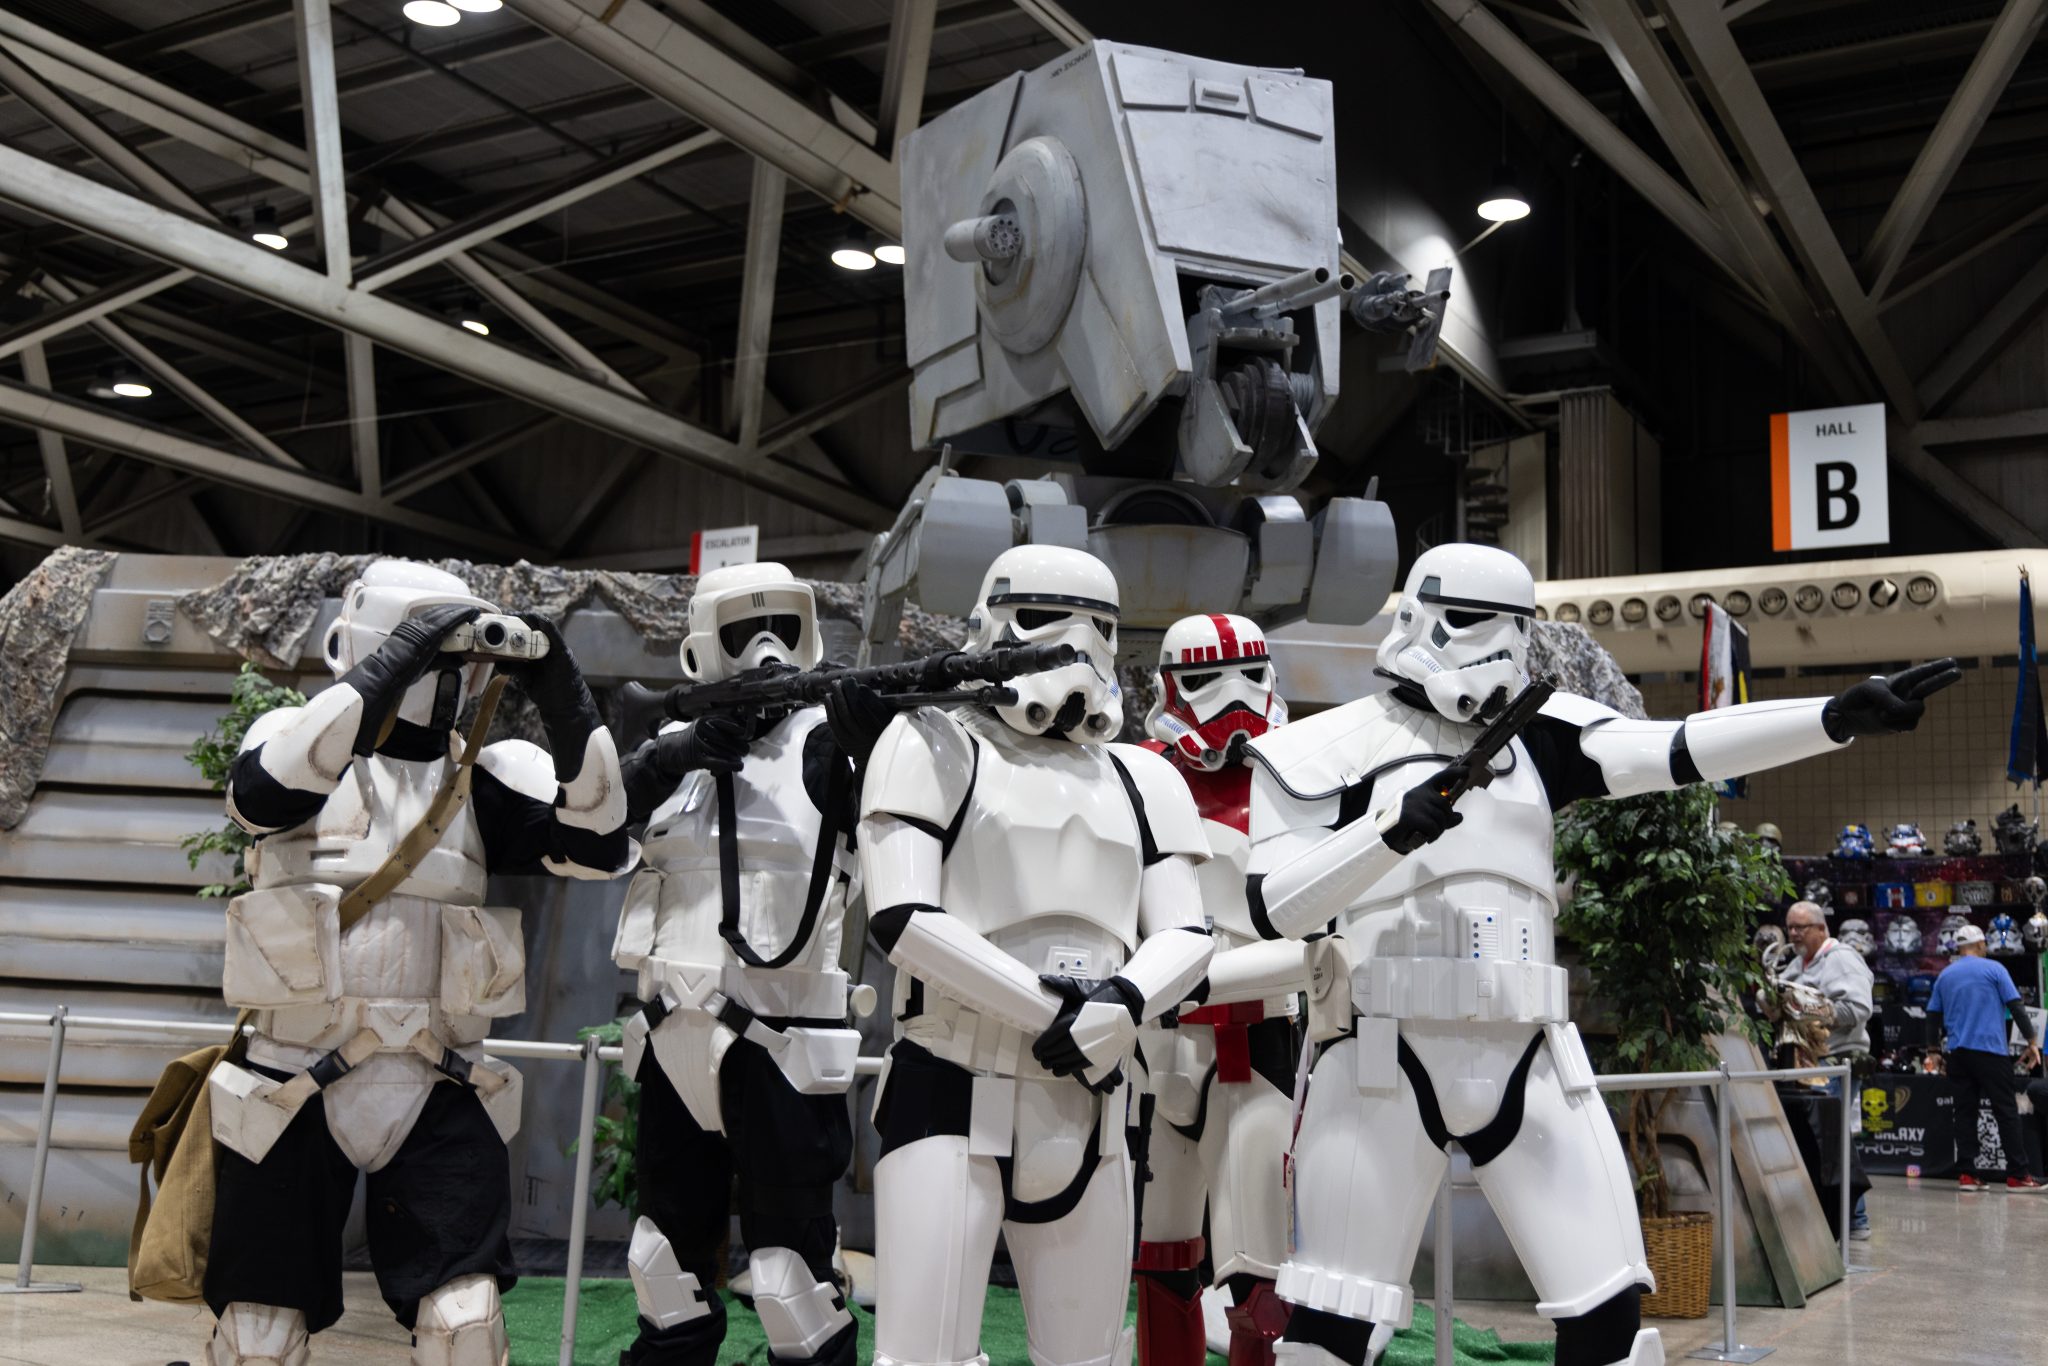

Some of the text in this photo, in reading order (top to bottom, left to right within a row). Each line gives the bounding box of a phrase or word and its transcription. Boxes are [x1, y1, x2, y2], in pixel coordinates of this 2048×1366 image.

[1816, 421, 1857, 437] HALL
[1815, 461, 1861, 532] B
[705, 536, 751, 550] ESCALATOR
